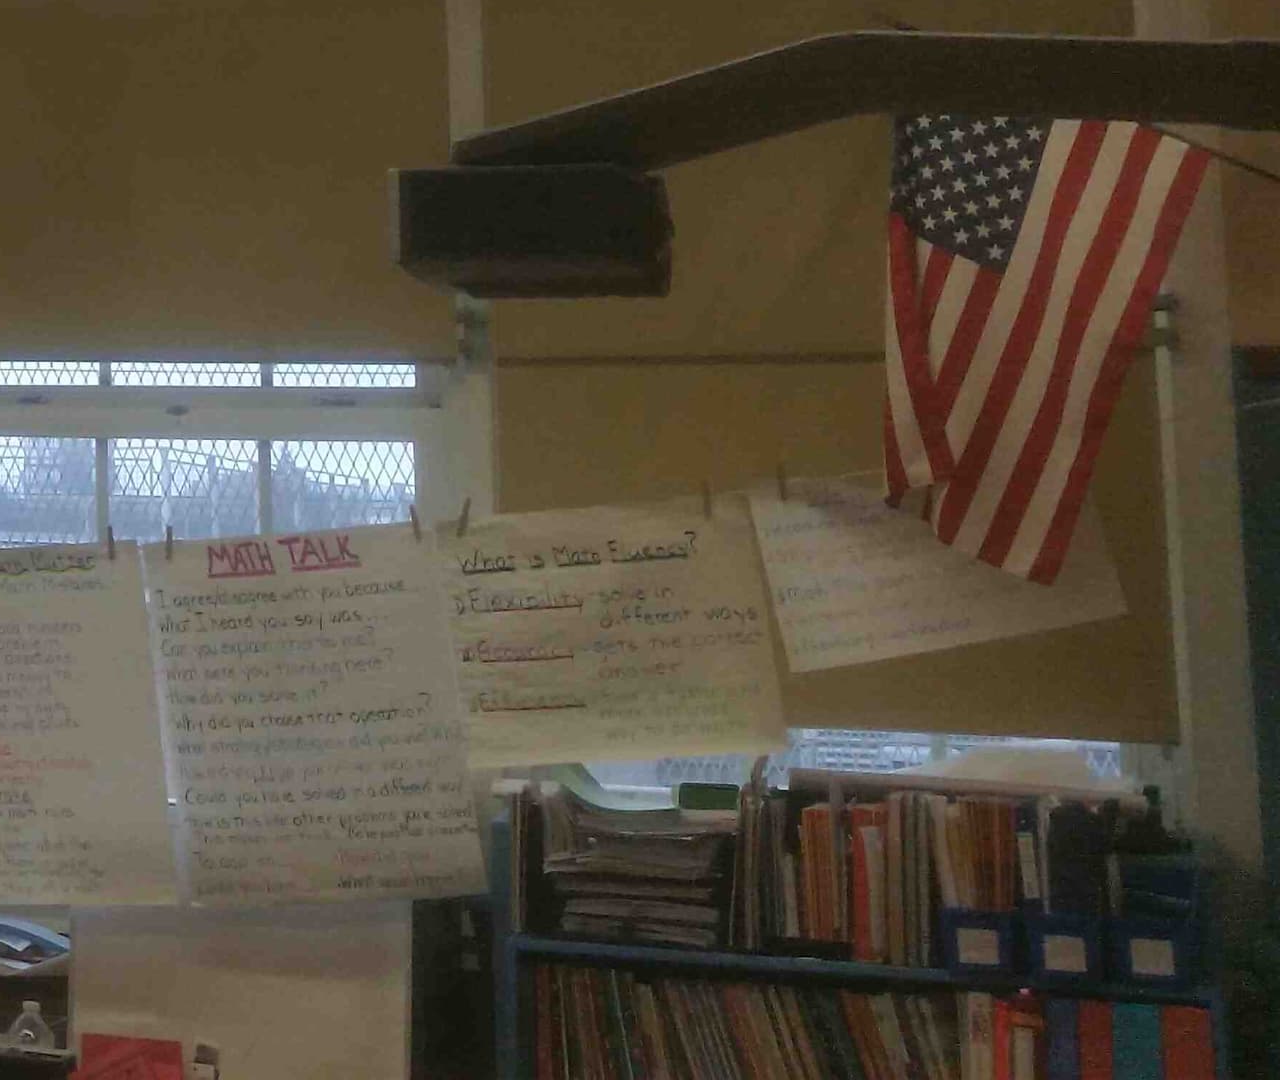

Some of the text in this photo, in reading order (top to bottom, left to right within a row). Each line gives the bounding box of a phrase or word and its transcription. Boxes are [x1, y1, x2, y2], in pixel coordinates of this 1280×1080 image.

[207, 534, 361, 577] MATH TALK
[457, 548, 517, 575] What
[156, 589, 165, 608] I
[210, 613, 254, 631] heard
[294, 614, 324, 631] say
